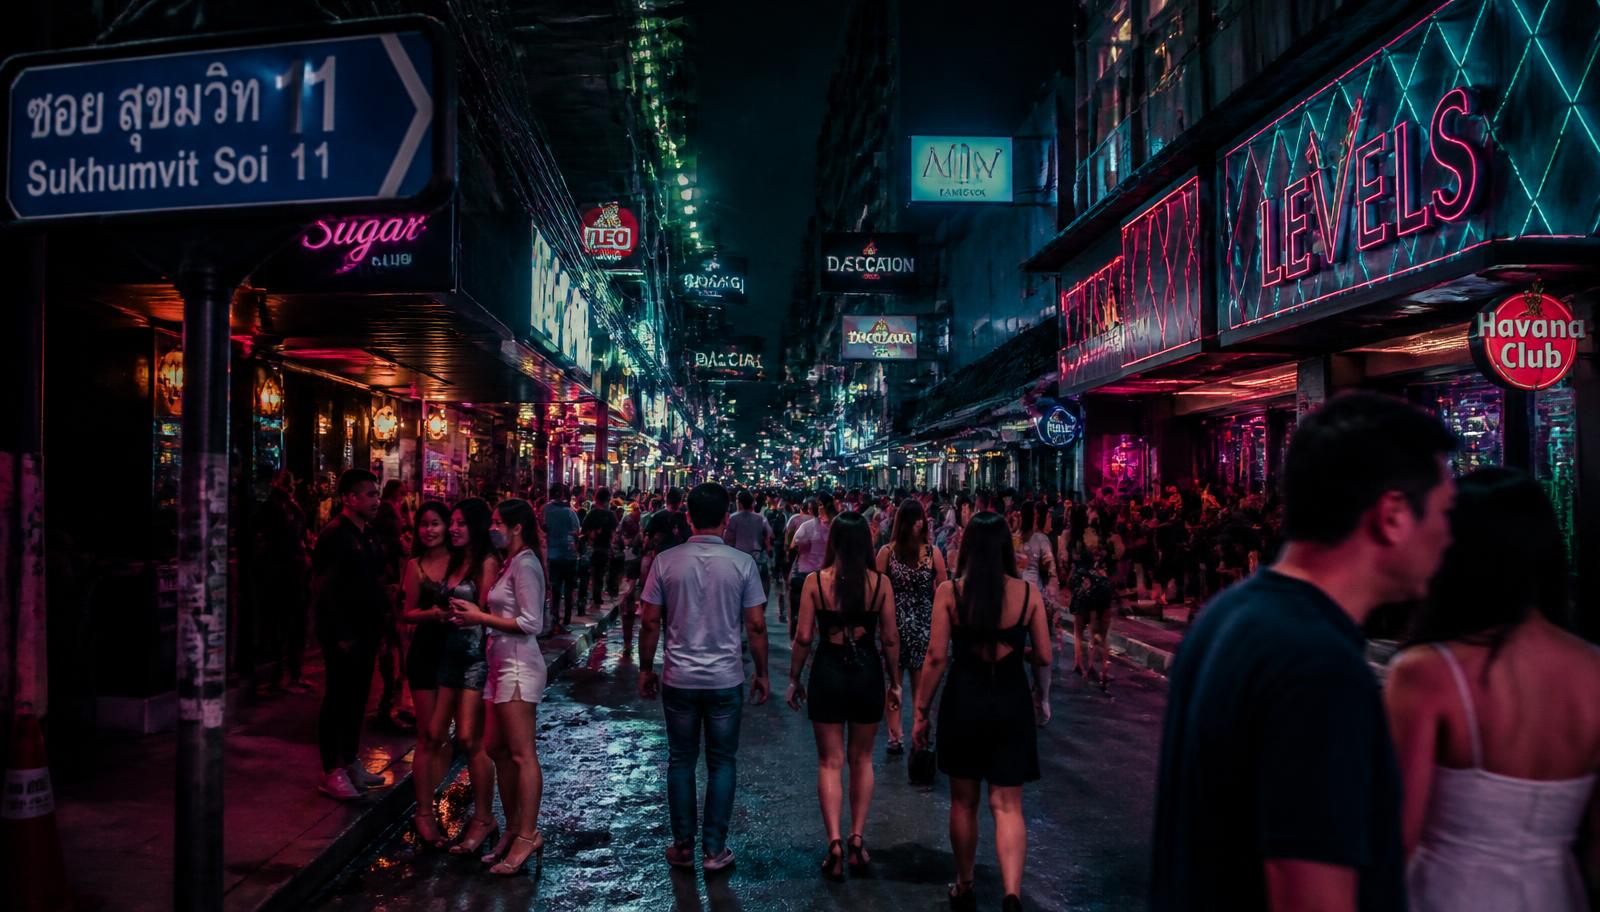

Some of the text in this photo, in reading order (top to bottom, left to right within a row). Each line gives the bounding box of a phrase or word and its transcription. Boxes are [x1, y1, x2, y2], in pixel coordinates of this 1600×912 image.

[27, 91, 103, 138] ซอย
[275, 56, 336, 133] 11
[27, 141, 329, 197] Sukhumvit Soi 11
[1260, 87, 1477, 287] LEVELS
[302, 215, 427, 274] Sugar
[592, 229, 629, 247] LEO
[1477, 312, 1586, 338] Havana
[1501, 341, 1562, 369] Club
